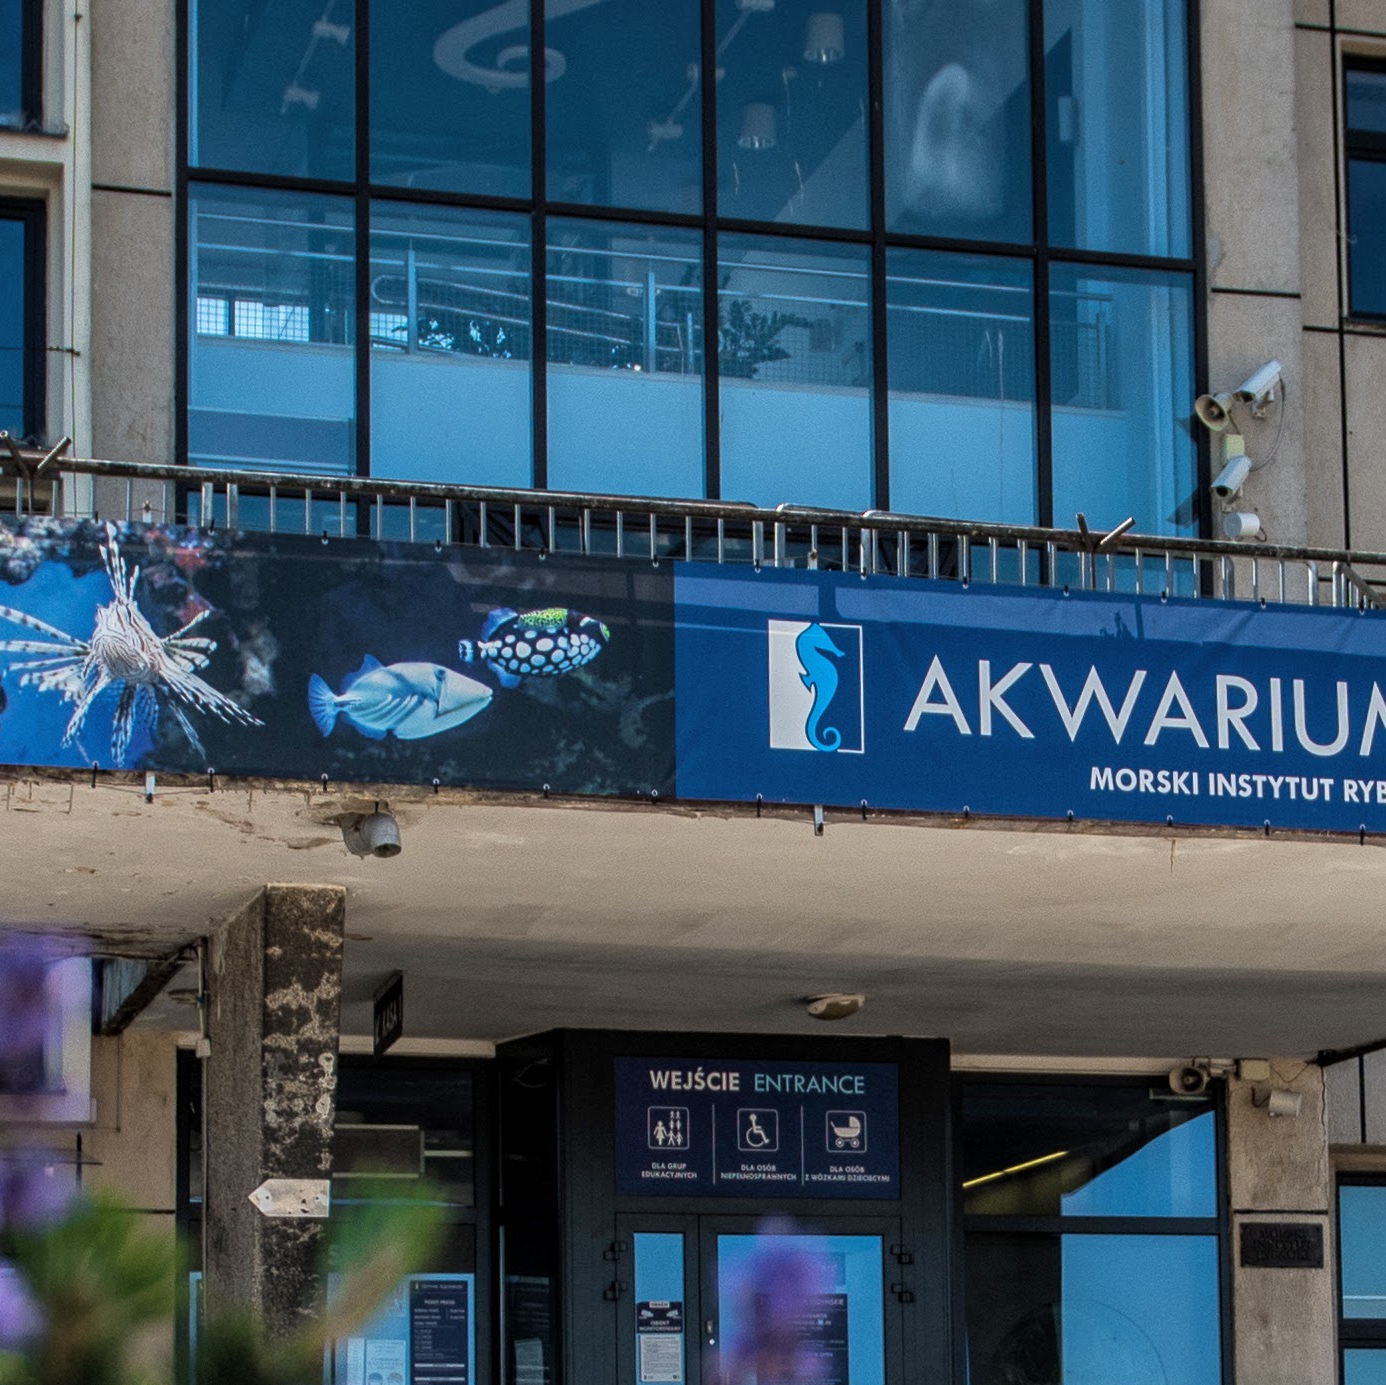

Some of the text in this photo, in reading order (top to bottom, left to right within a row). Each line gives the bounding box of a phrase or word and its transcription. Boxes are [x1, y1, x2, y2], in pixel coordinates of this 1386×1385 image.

[1089, 766, 1200, 795] MORSKI
[1208, 772, 1335, 802] INSTYTUT
[649, 1066, 865, 1095] WEJŚCIE ENTRANCE
[651, 1162, 687, 1170] DLA GRUP
[740, 1162, 777, 1172] DLA OSÓB
[829, 1164, 865, 1174] DLA OSÓB
[641, 1170, 698, 1179] EDUKACYJNYCH
